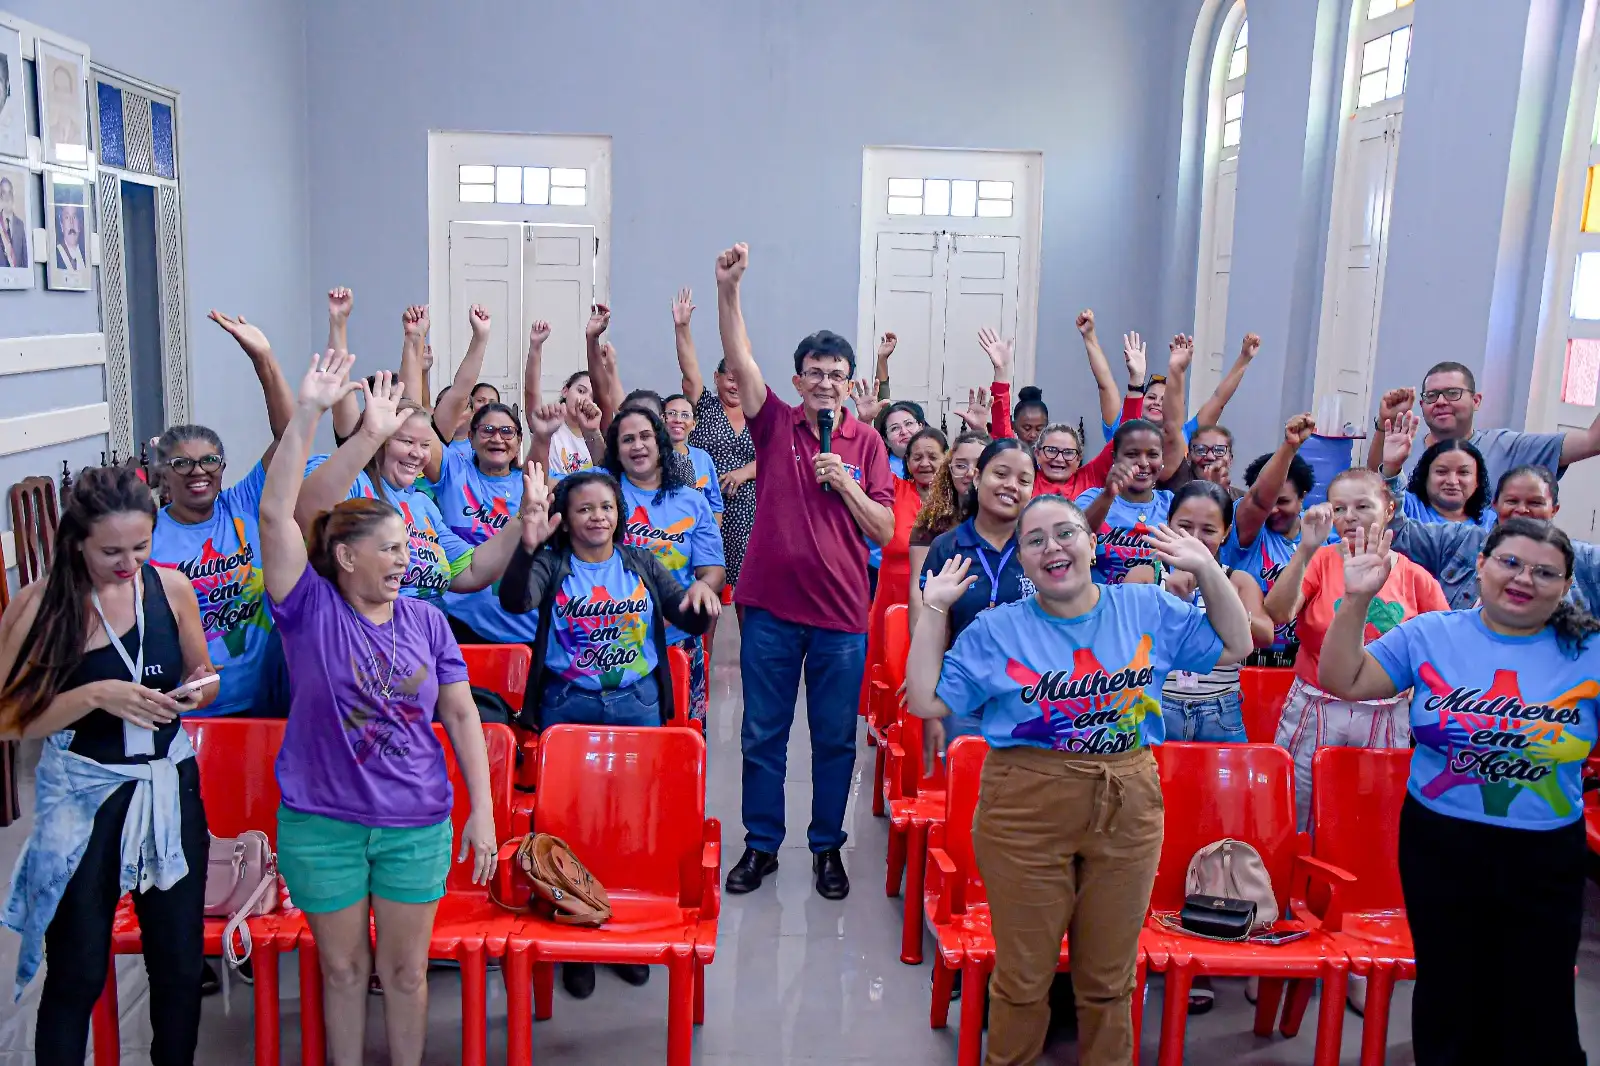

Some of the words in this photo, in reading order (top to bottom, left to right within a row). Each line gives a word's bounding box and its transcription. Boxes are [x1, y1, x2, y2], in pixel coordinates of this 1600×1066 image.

[177, 542, 254, 581] Mulheres
[417, 547, 439, 564] em
[208, 581, 244, 605] em
[556, 594, 648, 619] Mulheres
[203, 600, 261, 632] Ação
[589, 625, 622, 643] em
[576, 643, 639, 672] Ação
[1020, 665, 1155, 705] Mulheres
[1072, 708, 1122, 730] em
[1423, 686, 1580, 726] Mulheres
[1470, 729, 1531, 749] em
[1451, 750, 1551, 783] Ação
